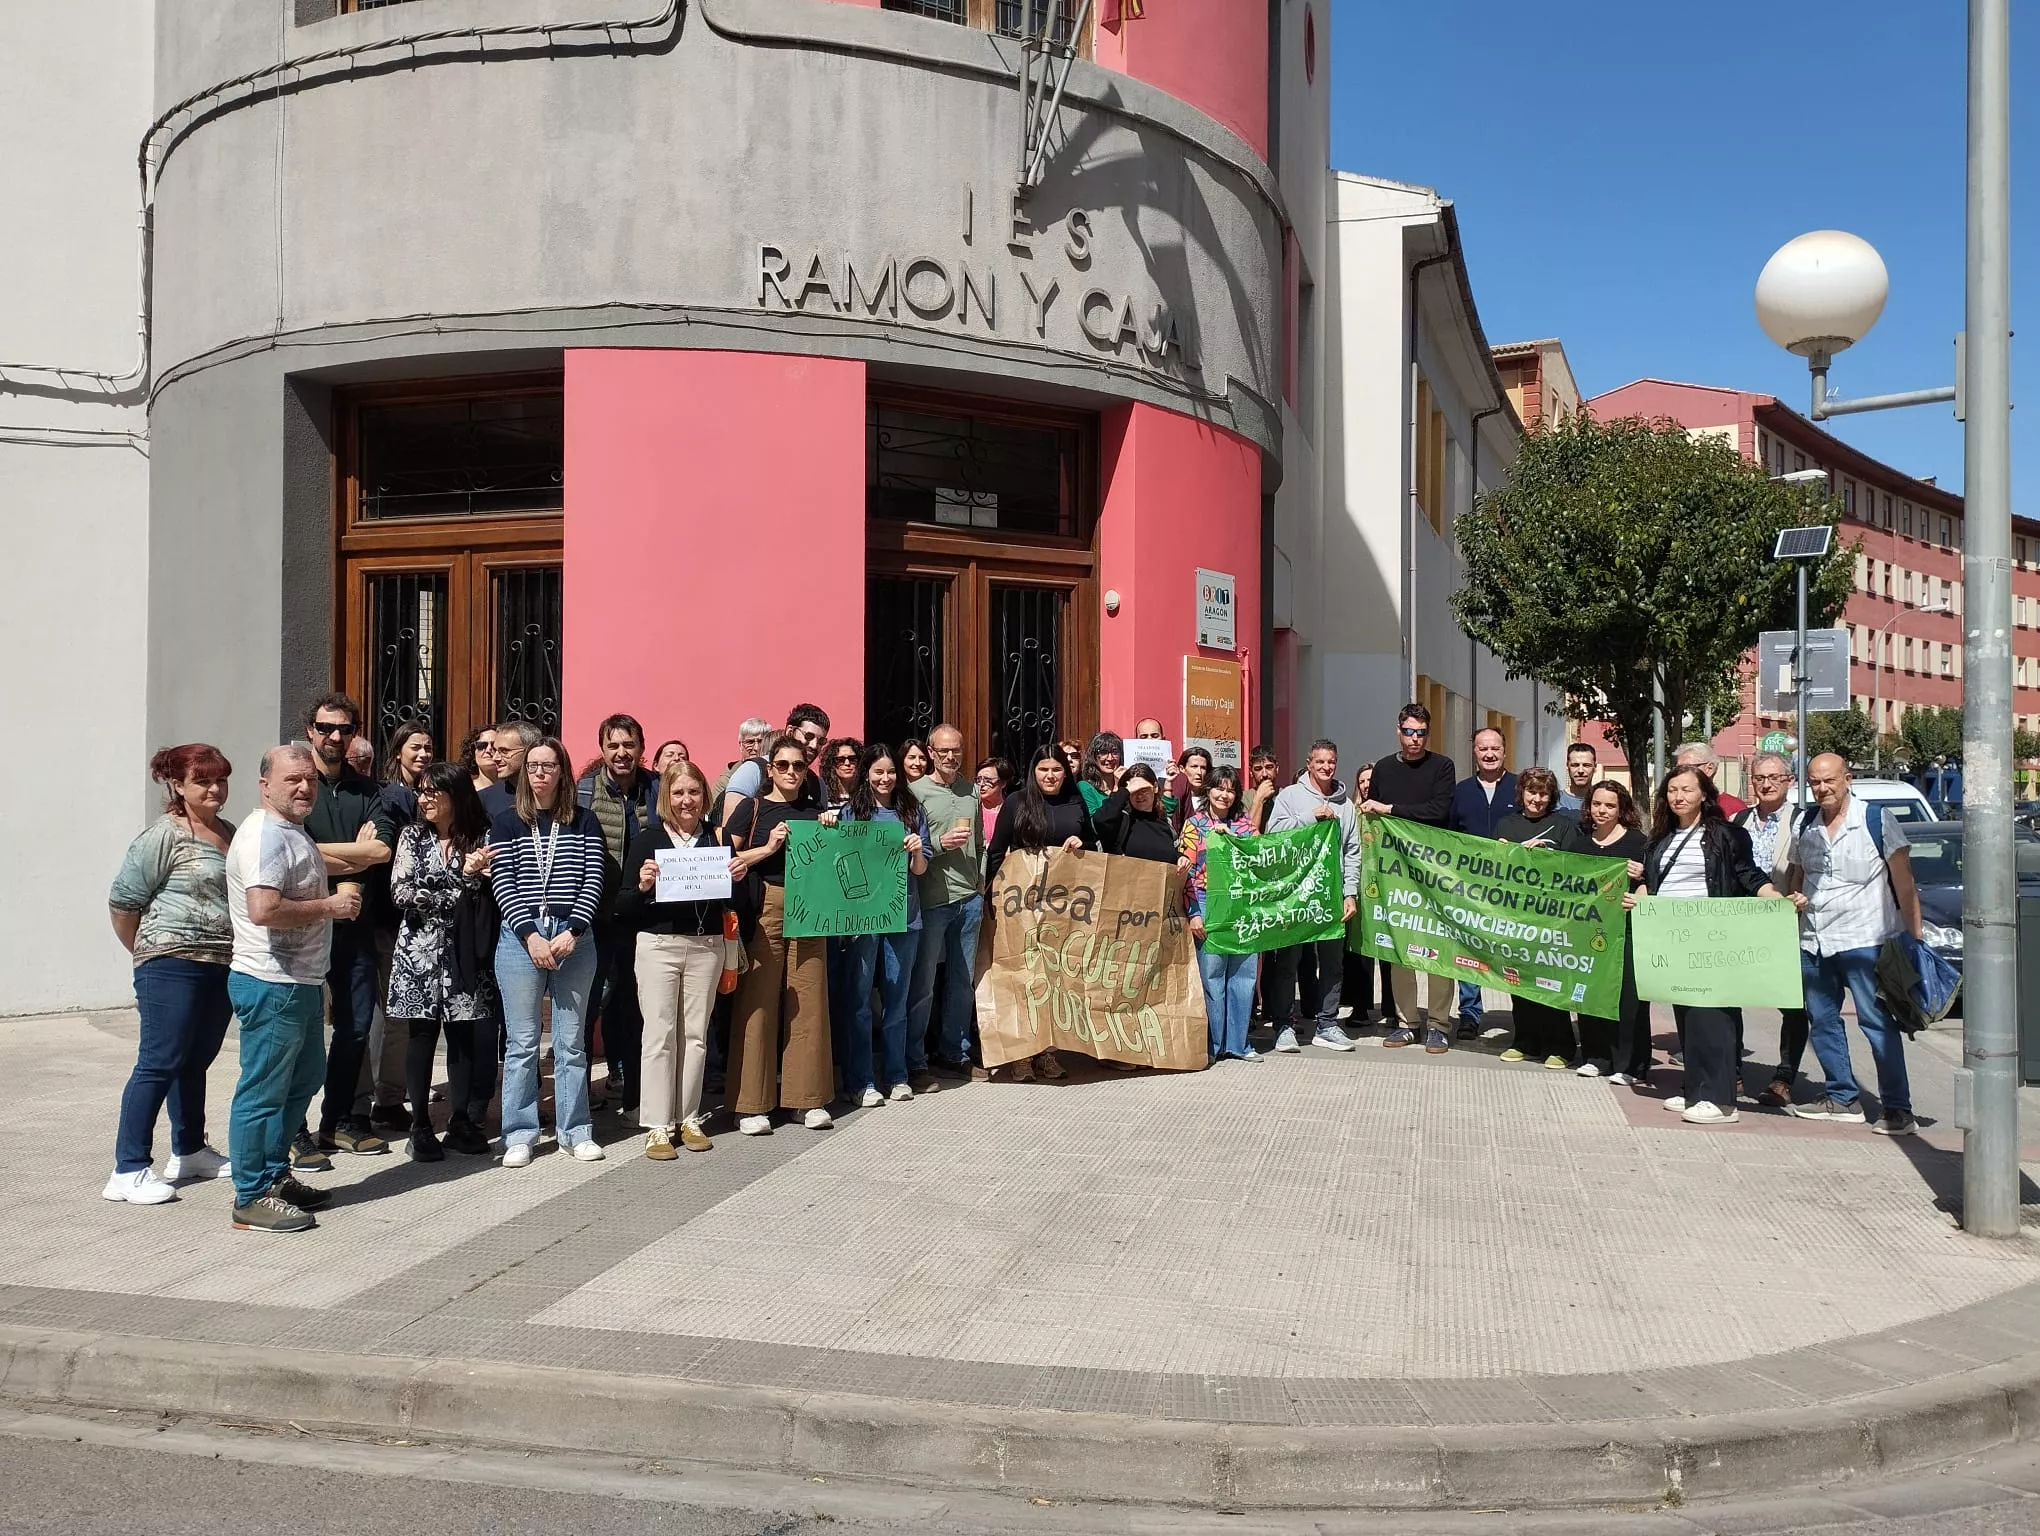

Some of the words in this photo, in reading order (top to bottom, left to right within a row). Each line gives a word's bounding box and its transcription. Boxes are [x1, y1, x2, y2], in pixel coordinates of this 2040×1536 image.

[757, 243, 996, 330] RAMON
[1020, 271, 1060, 337] Y
[1191, 695, 1213, 706] Ramón
[1214, 700, 1219, 710] y
[1220, 698, 1235, 715] Cajal
[788, 828, 827, 879] ¿QUÉ
[840, 823, 868, 838] SERÍA
[876, 830, 889, 847] DE
[1381, 832, 1452, 867] DINERO
[1456, 852, 1544, 890] PÚBLICO,
[1551, 872, 1599, 896] PARA
[787, 895, 810, 924] SIN
[814, 914, 830, 932] LA
[1378, 856, 1403, 877] LA
[1408, 864, 1519, 909] EDUCACIÓN
[1523, 892, 1603, 922] PÚBLICA
[1639, 902, 1657, 916] LA
[1116, 909, 1160, 939] por
[1238, 911, 1285, 939] PARA
[1373, 904, 1483, 949] BACHILLERATO
[1485, 939, 1497, 953] Y
[1500, 943, 1531, 962] 0-3
[1534, 947, 1595, 974] AÑOS!
[1387, 888, 1422, 907] ¡NO
[1424, 898, 1441, 916] AL
[1443, 905, 1538, 941] CONCIERTO
[1540, 927, 1574, 947] DEL
[1025, 922, 1162, 998] ESCUELA
[1651, 953, 1669, 968] UN
